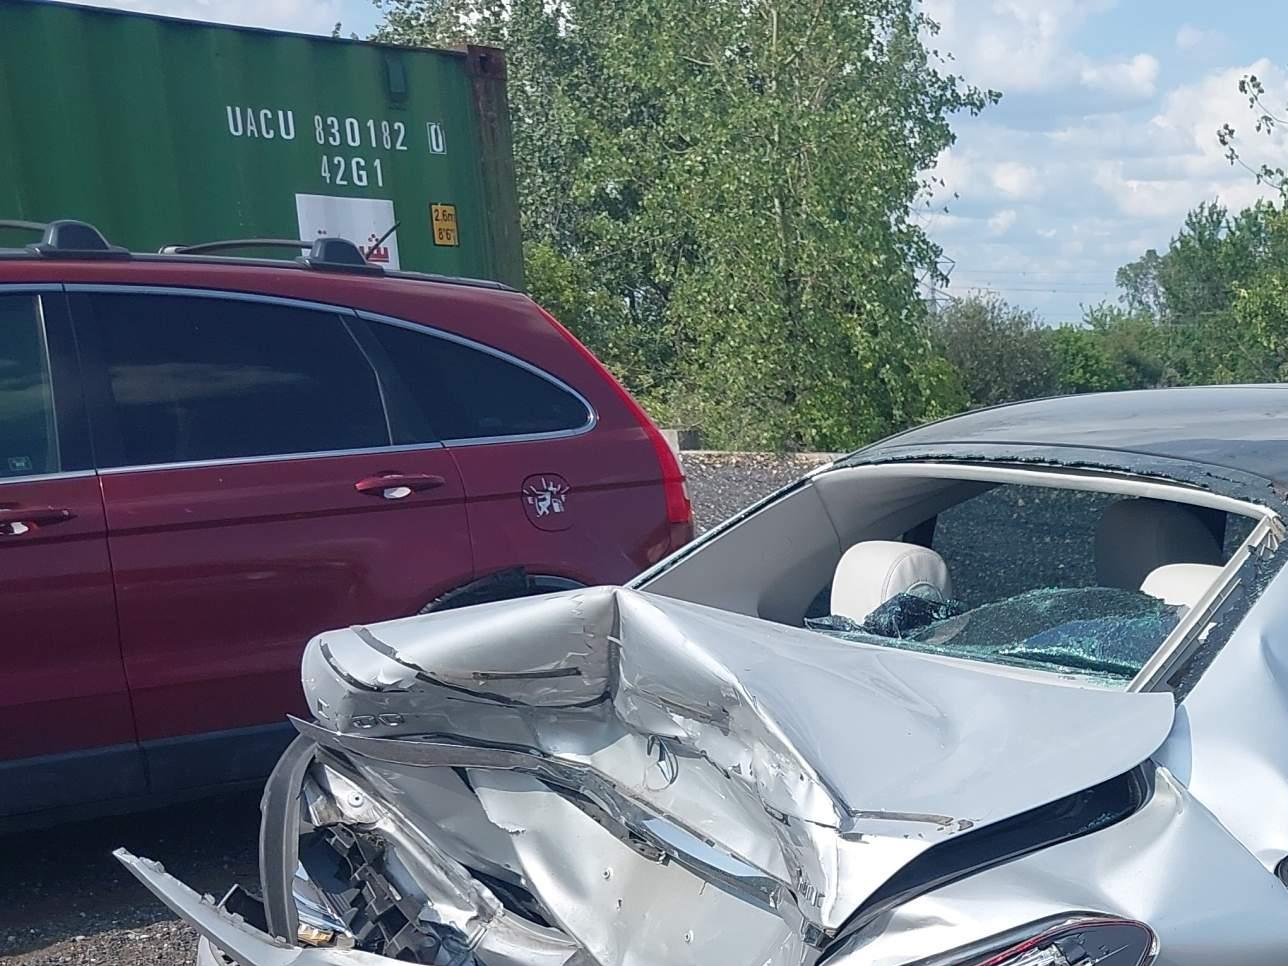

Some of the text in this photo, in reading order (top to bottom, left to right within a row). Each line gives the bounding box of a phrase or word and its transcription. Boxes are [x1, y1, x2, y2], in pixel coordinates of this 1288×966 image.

[226, 105, 445, 153] UACU 830182 0
[320, 155, 384, 187] 42G1
